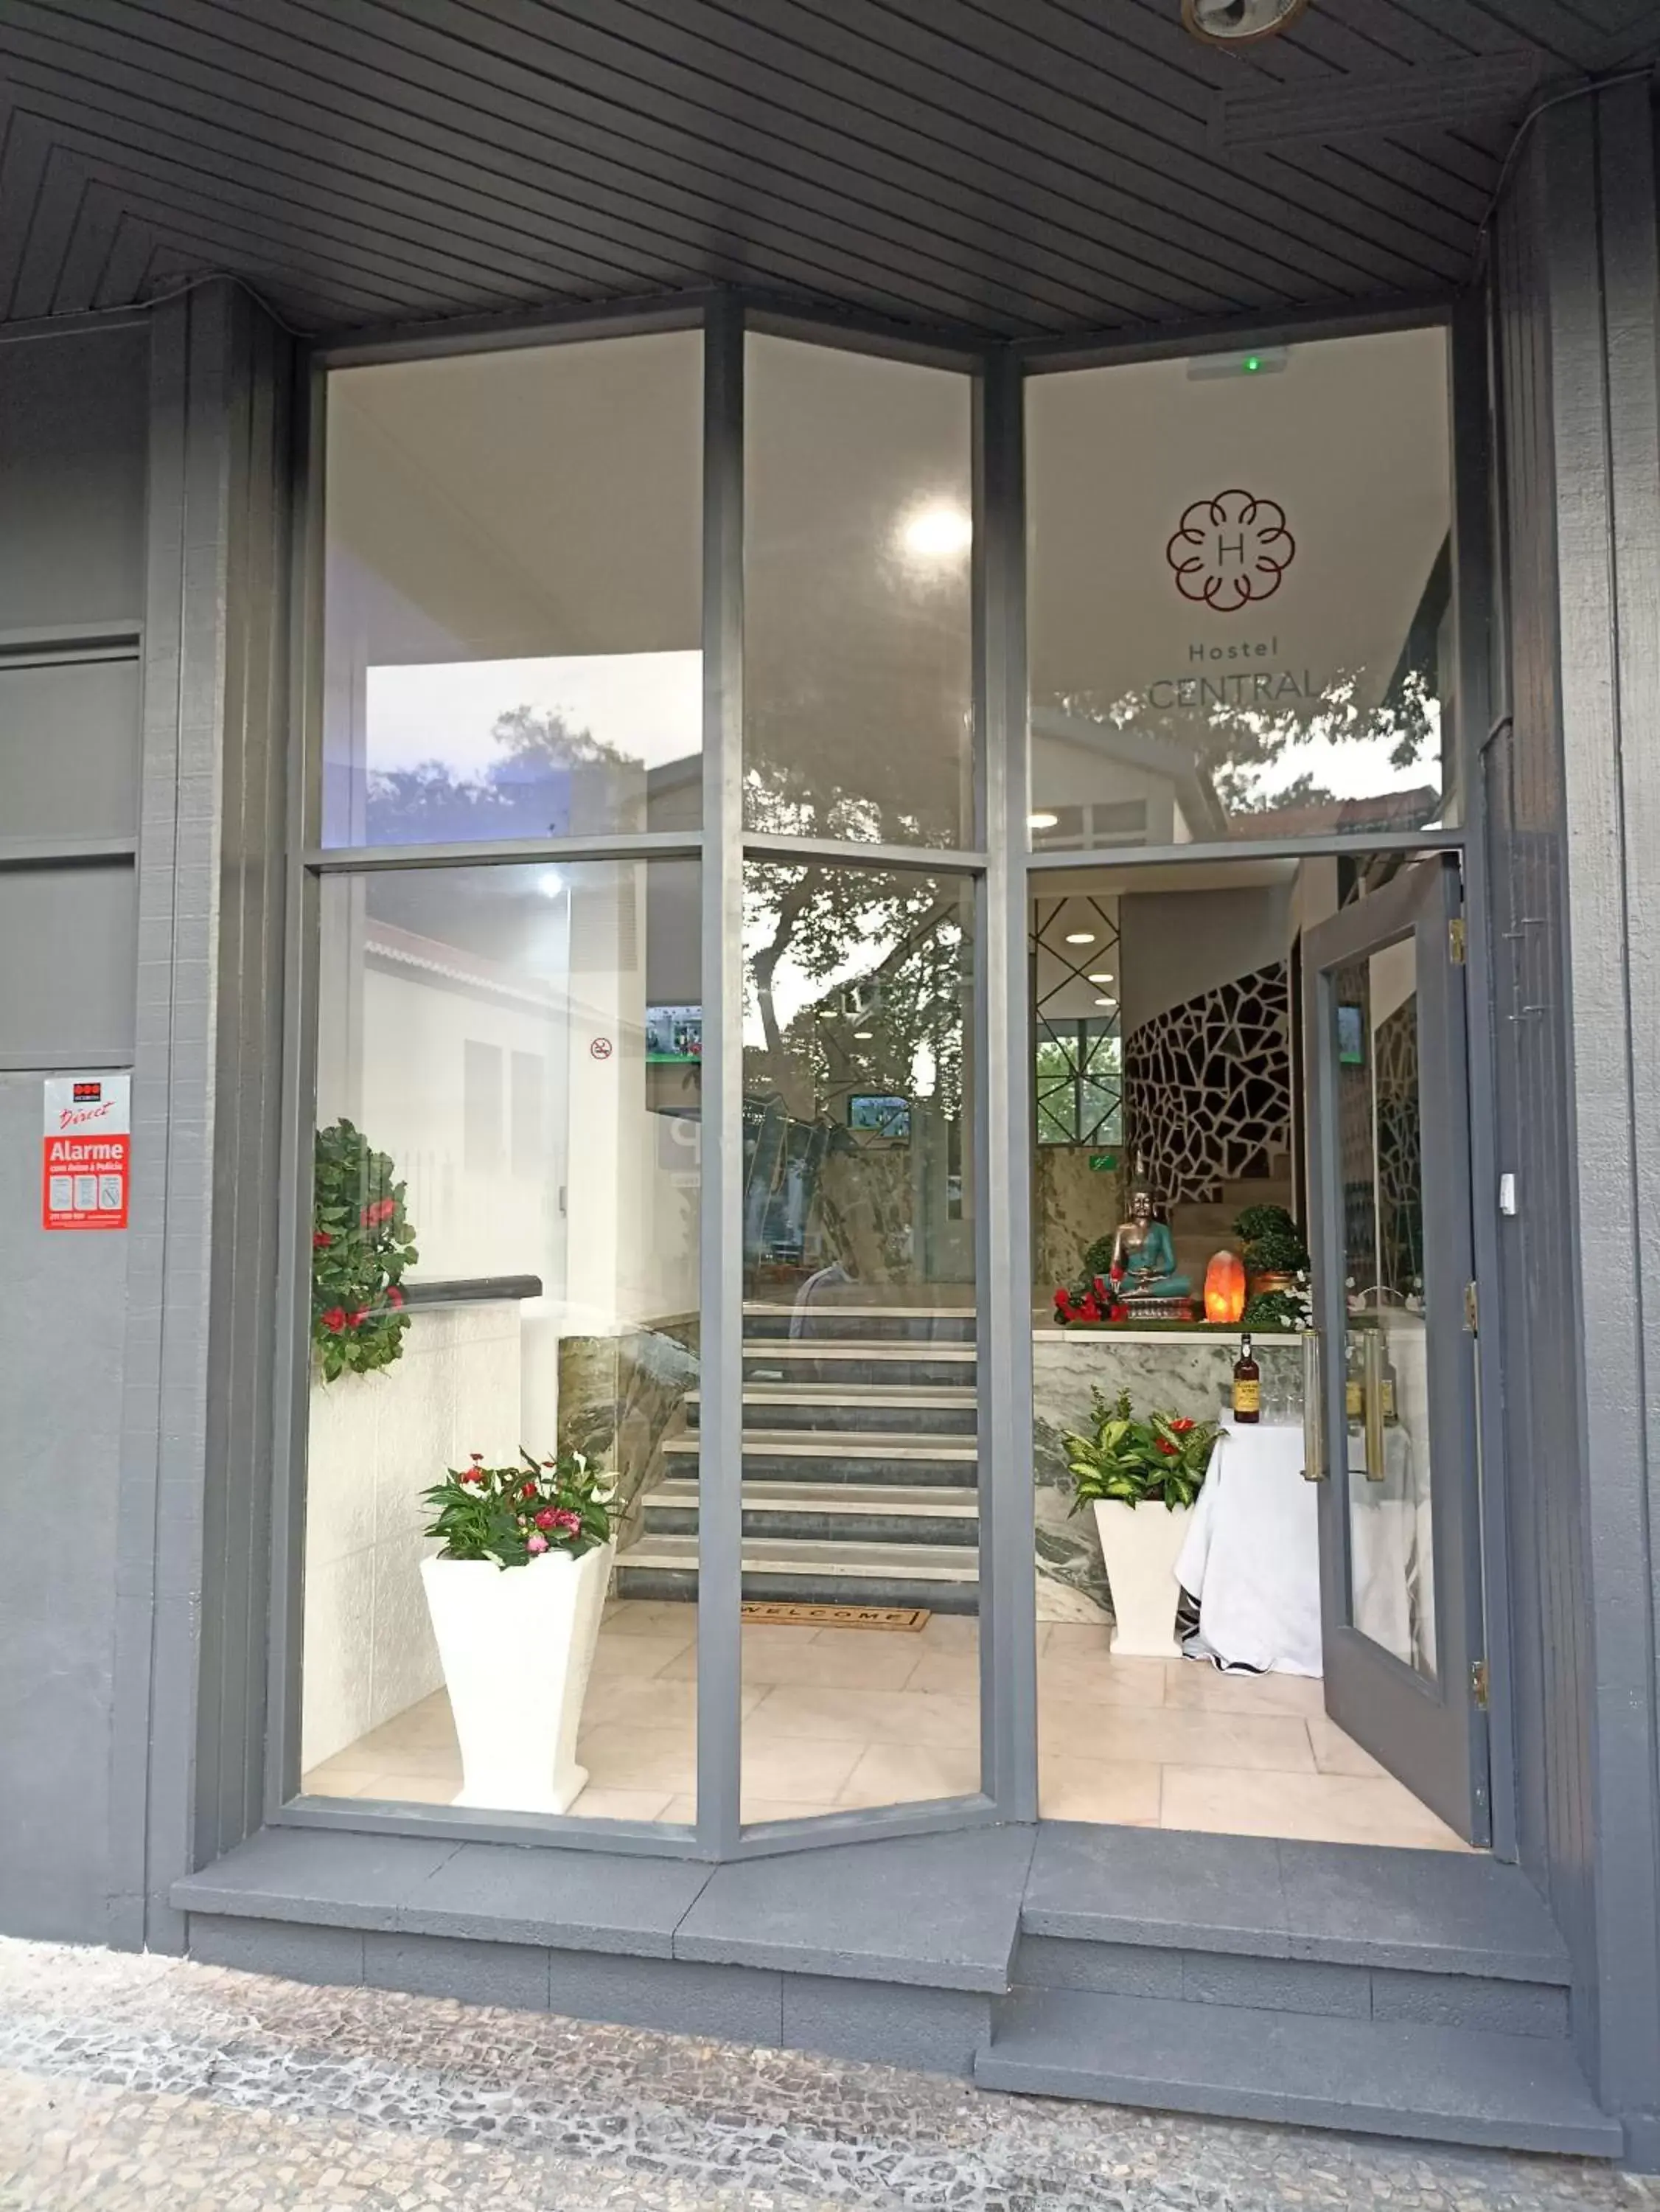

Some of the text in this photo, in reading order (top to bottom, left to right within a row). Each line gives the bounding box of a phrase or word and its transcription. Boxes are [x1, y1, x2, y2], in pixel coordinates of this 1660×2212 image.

[1218, 532, 1244, 566] H
[1189, 636, 1277, 662] Hostel
[1148, 669, 1320, 709] CENTRAL
[59, 1101, 116, 1130] Direct
[49, 1141, 124, 1161] Alarme
